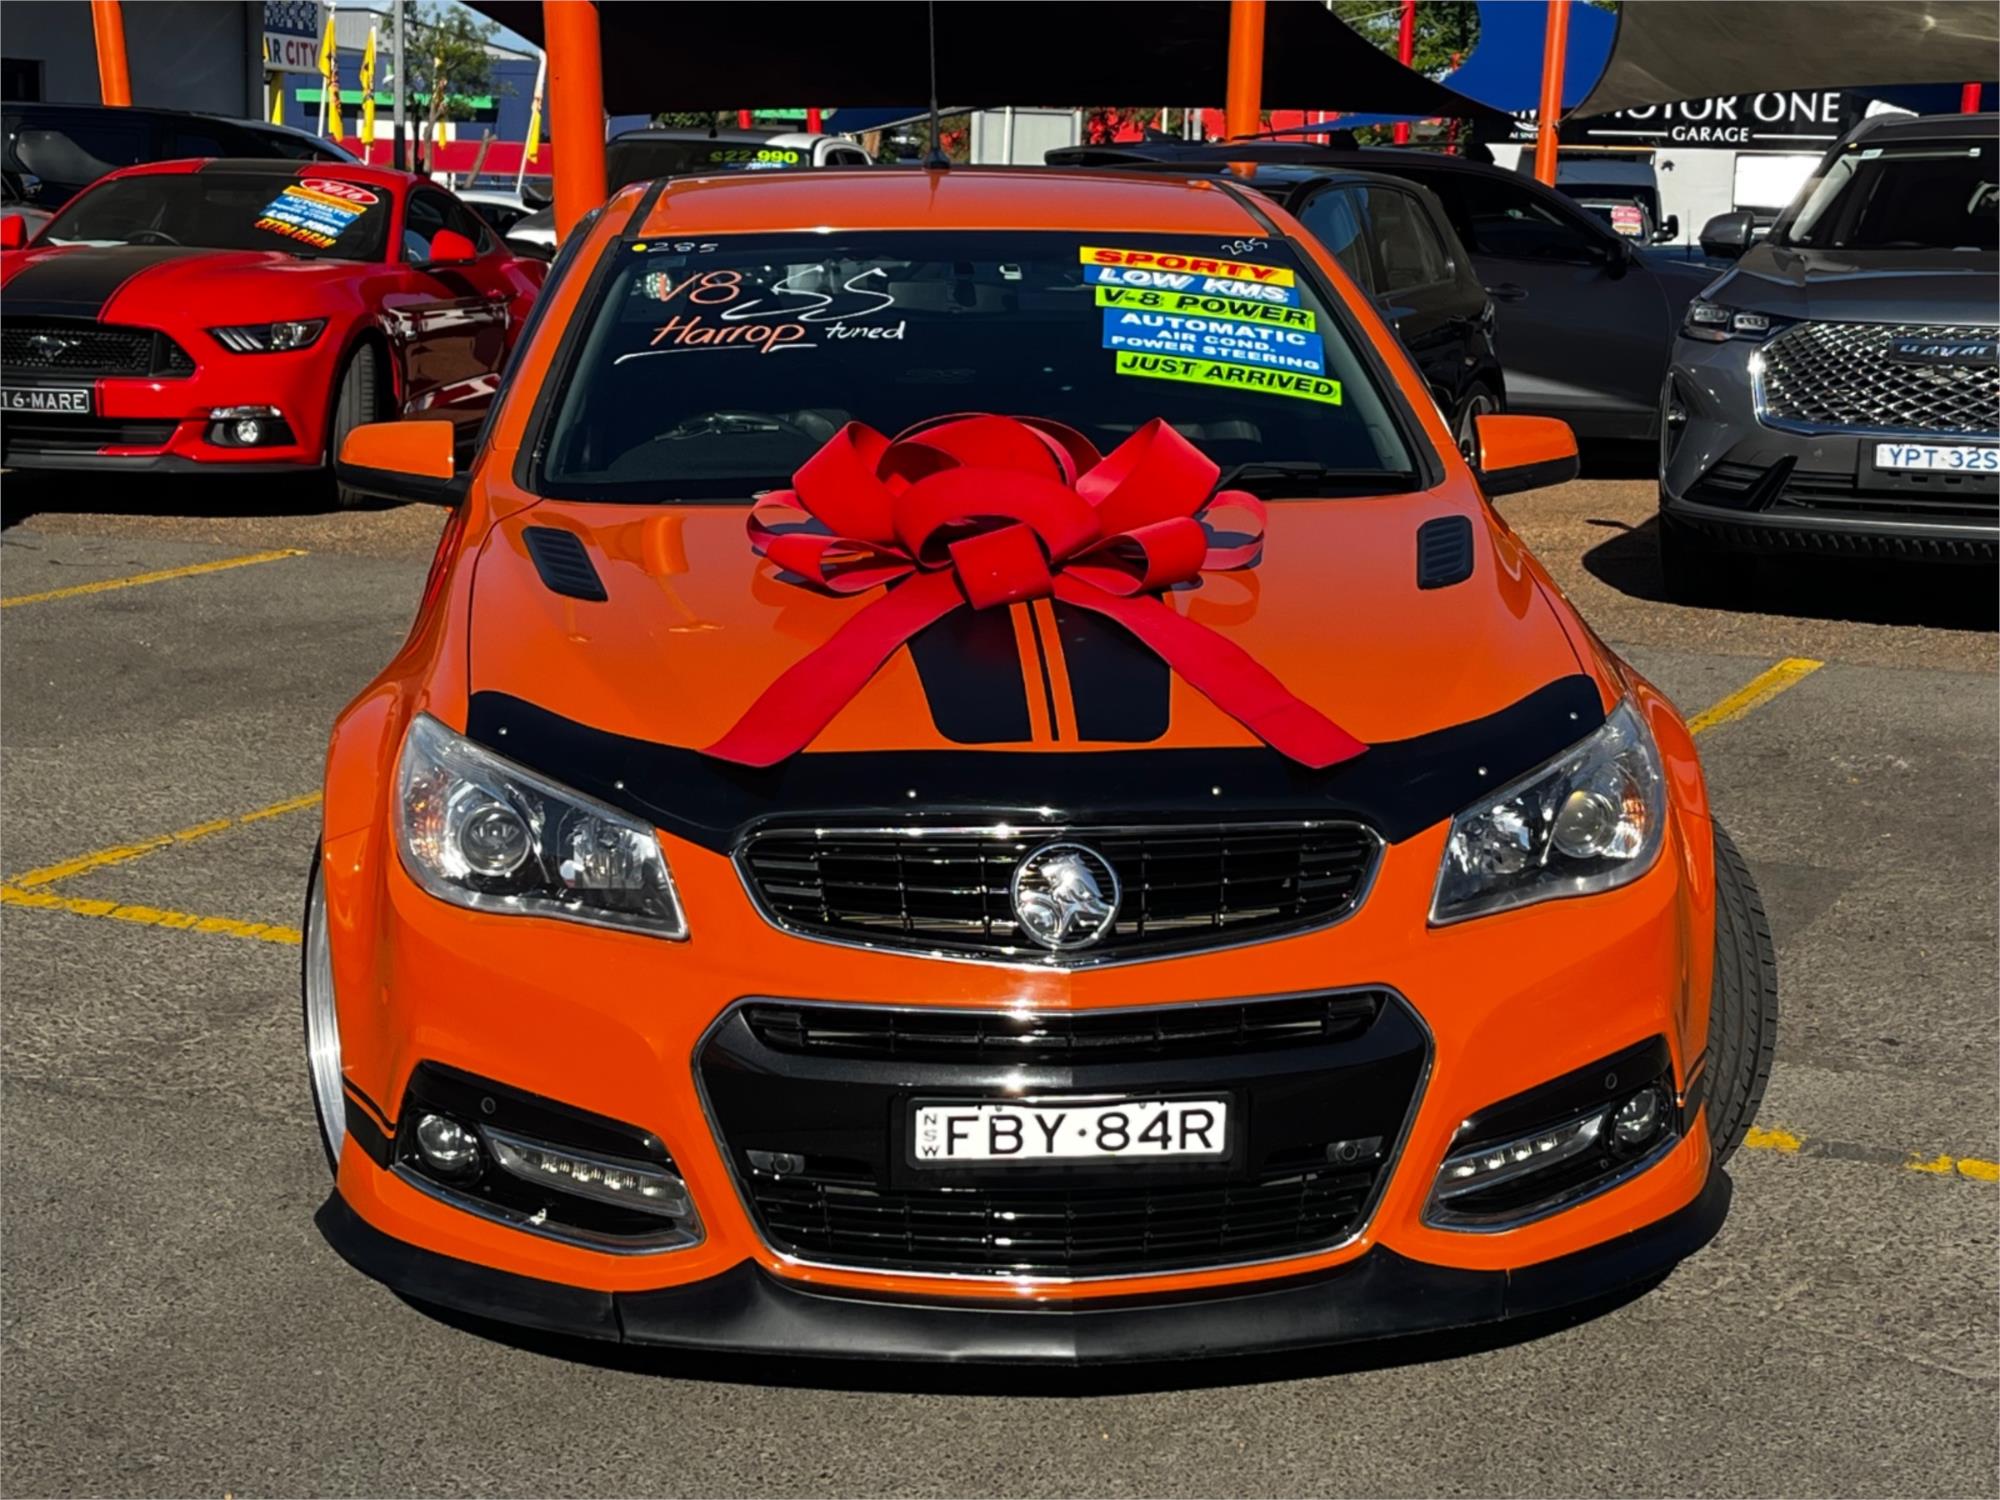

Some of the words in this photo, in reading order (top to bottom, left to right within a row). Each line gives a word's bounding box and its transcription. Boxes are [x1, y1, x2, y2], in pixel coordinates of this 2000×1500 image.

[286, 40, 318, 68] CITY
[1602, 96, 1738, 120] TOR
[1753, 92, 1841, 122] ONE
[1671, 126, 1749, 142] GARAGE
[648, 242, 719, 253] 285
[1220, 237, 1269, 256] 285
[1093, 249, 1280, 280] SPORTY
[657, 270, 742, 304] V8
[721, 264, 895, 322] SS
[1098, 268, 1195, 290] LOW
[1203, 278, 1290, 304] KMS
[1103, 288, 1161, 307] V-8
[1176, 296, 1309, 326] POWER
[650, 315, 806, 354] Harrop
[824, 320, 906, 340] tuned
[1120, 313, 1307, 346] AUTOMATIC
[1156, 330, 1198, 342] AIR
[1203, 335, 1277, 352] COND.
[1111, 336, 1195, 353] POWER
[1202, 346, 1321, 371] STEERING
[1122, 355, 1198, 376] JUST
[1204, 365, 1335, 396] ARRIVED
